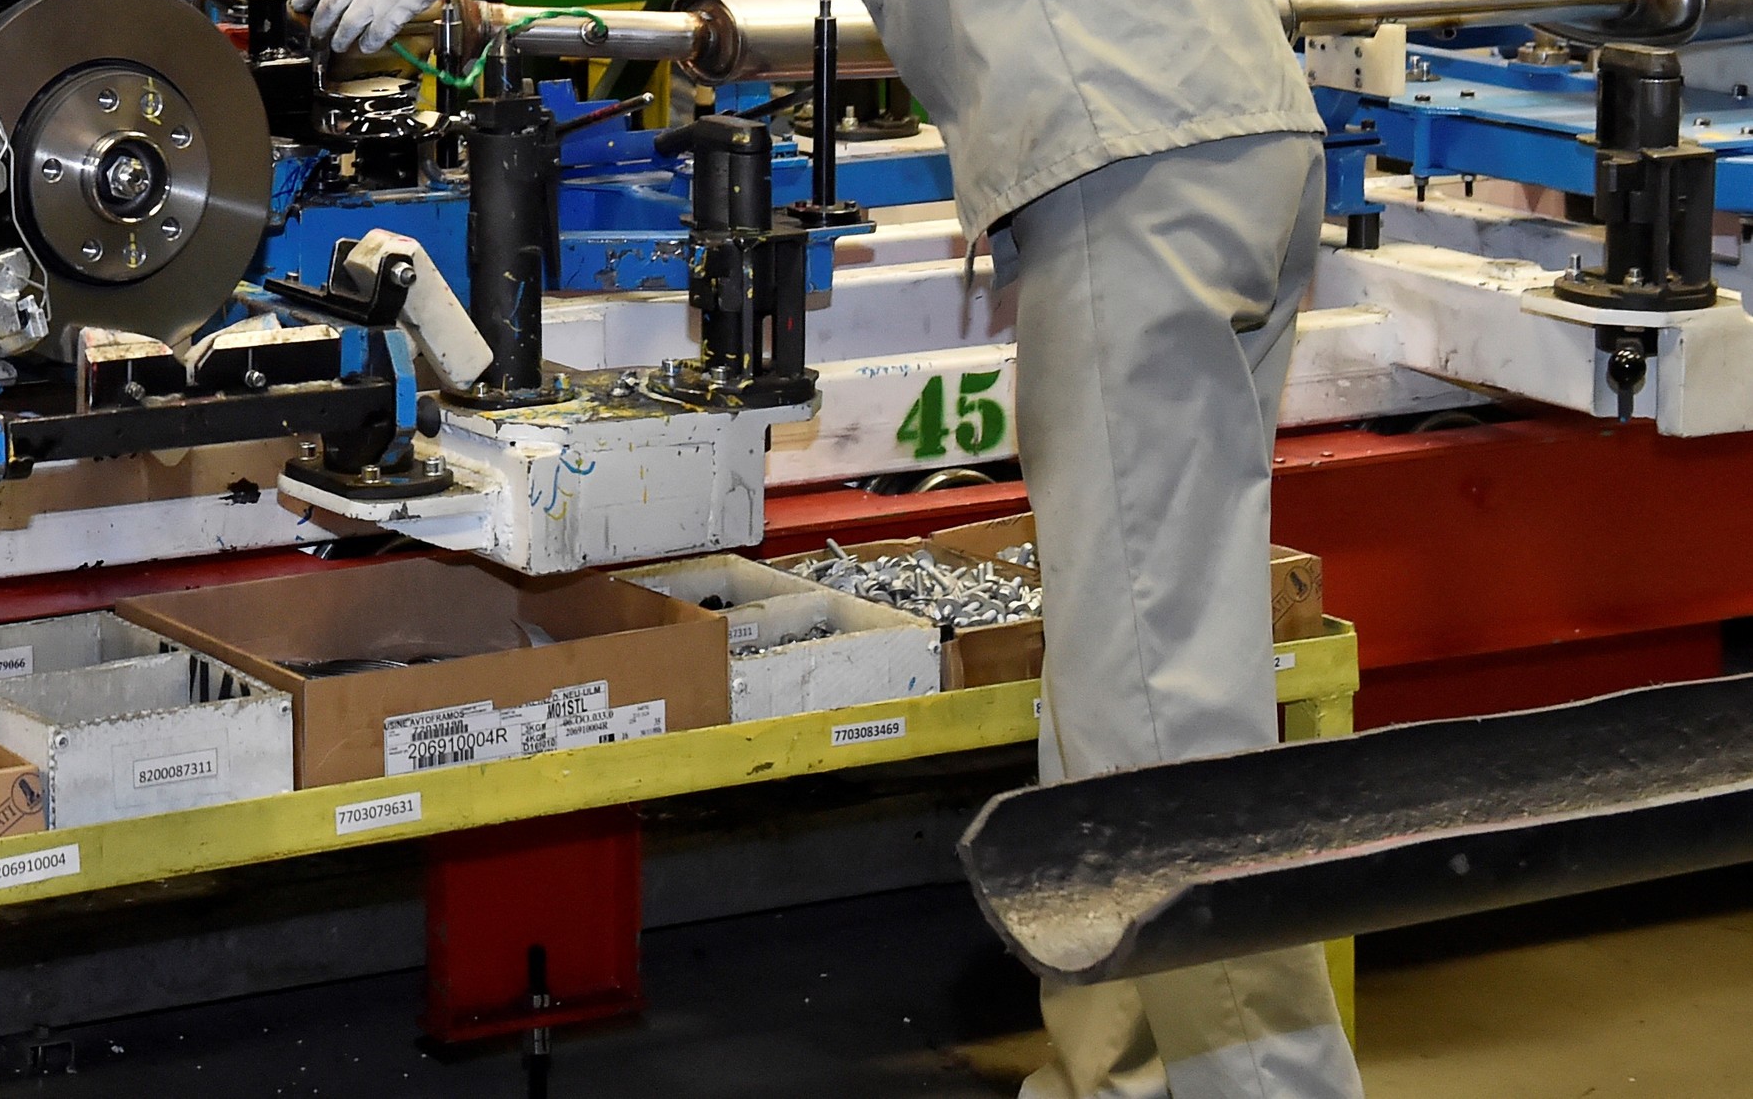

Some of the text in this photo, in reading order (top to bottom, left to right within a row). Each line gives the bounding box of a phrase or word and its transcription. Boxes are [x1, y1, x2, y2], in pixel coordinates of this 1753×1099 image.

[897, 369, 1006, 458] 45
[408, 727, 508, 759] 206910004R
[834, 723, 899, 741] 7703083469
[139, 761, 212, 783] 8200087311
[338, 799, 413, 824] 7703079631
